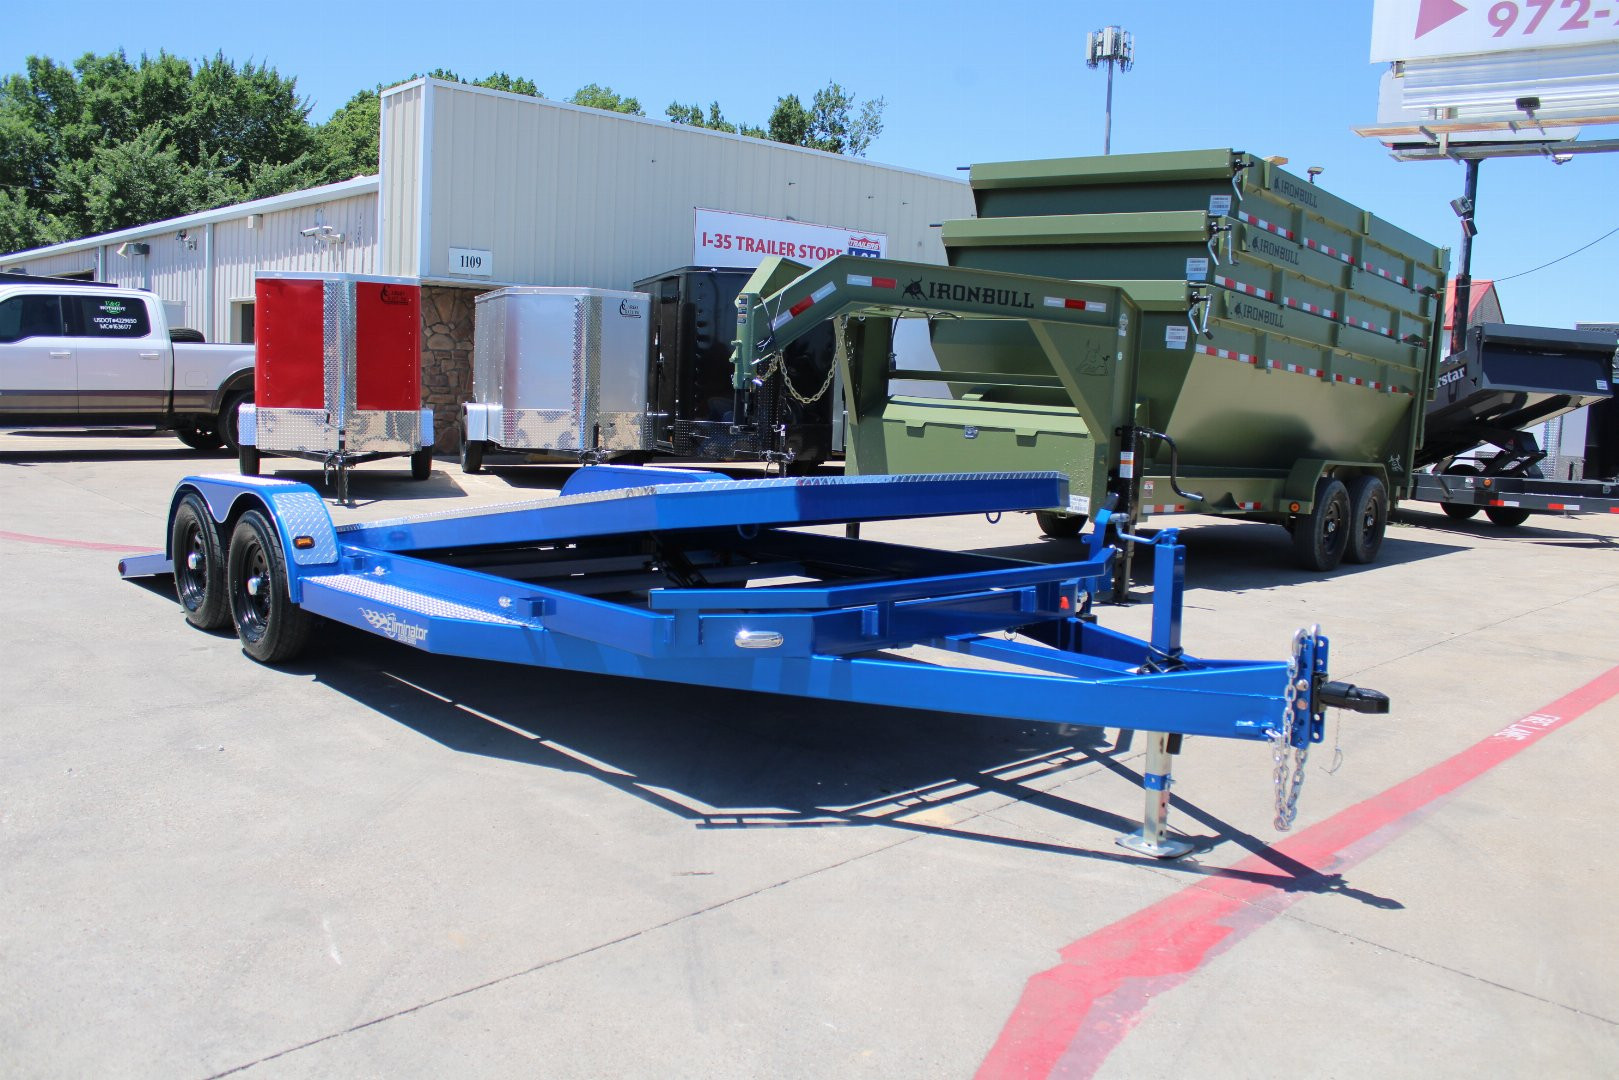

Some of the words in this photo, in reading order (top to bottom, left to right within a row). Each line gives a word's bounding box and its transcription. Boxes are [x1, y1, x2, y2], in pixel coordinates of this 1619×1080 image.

[1487, 0, 1619, 38] 972-
[1280, 179, 1318, 209] IRONBULL
[702, 232, 732, 250] I-35
[736, 235, 796, 257] TRAILER
[849, 239, 880, 250] TRAILERS
[1258, 237, 1299, 266] IRONBULL
[460, 255, 482, 269] 1109
[929, 281, 1034, 309] IRONBULL
[1242, 304, 1285, 329] IRONBULL
